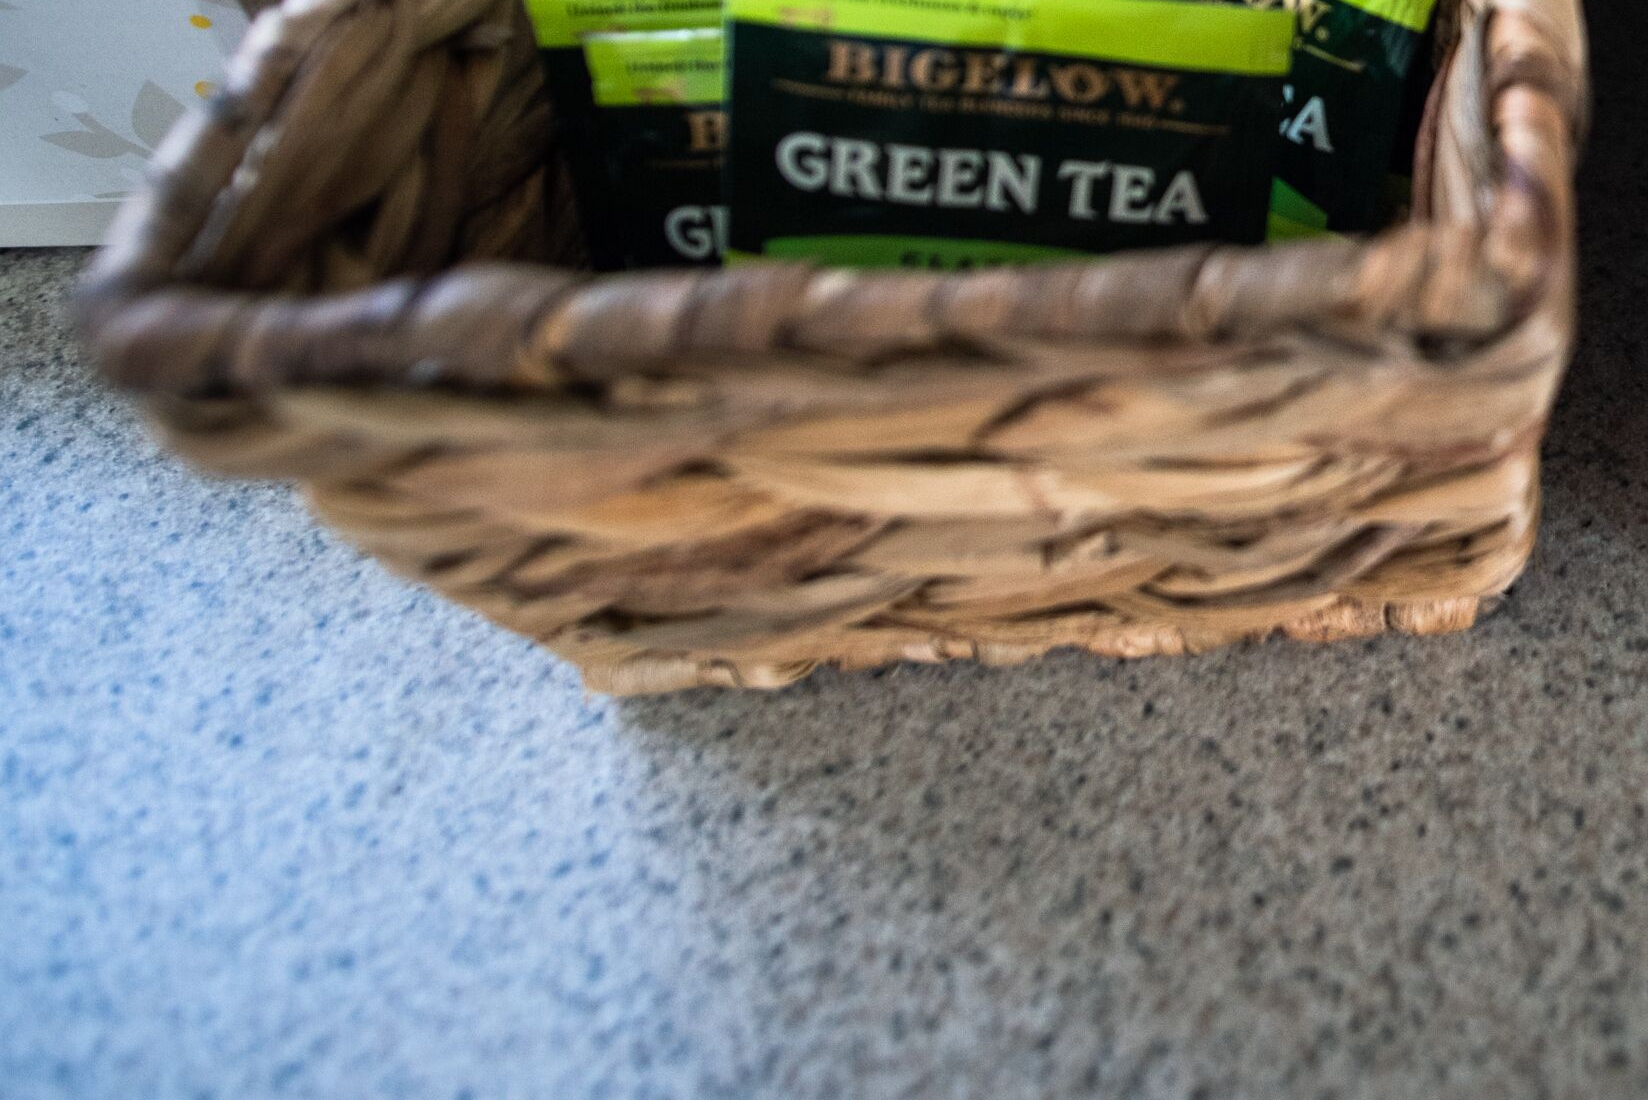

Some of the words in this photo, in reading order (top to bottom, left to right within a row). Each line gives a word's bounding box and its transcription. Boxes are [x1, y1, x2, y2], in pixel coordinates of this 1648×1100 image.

[826, 40, 1180, 108] BIGELOW
[775, 131, 1042, 215] GREEN
[1057, 159, 1208, 225] TEA
